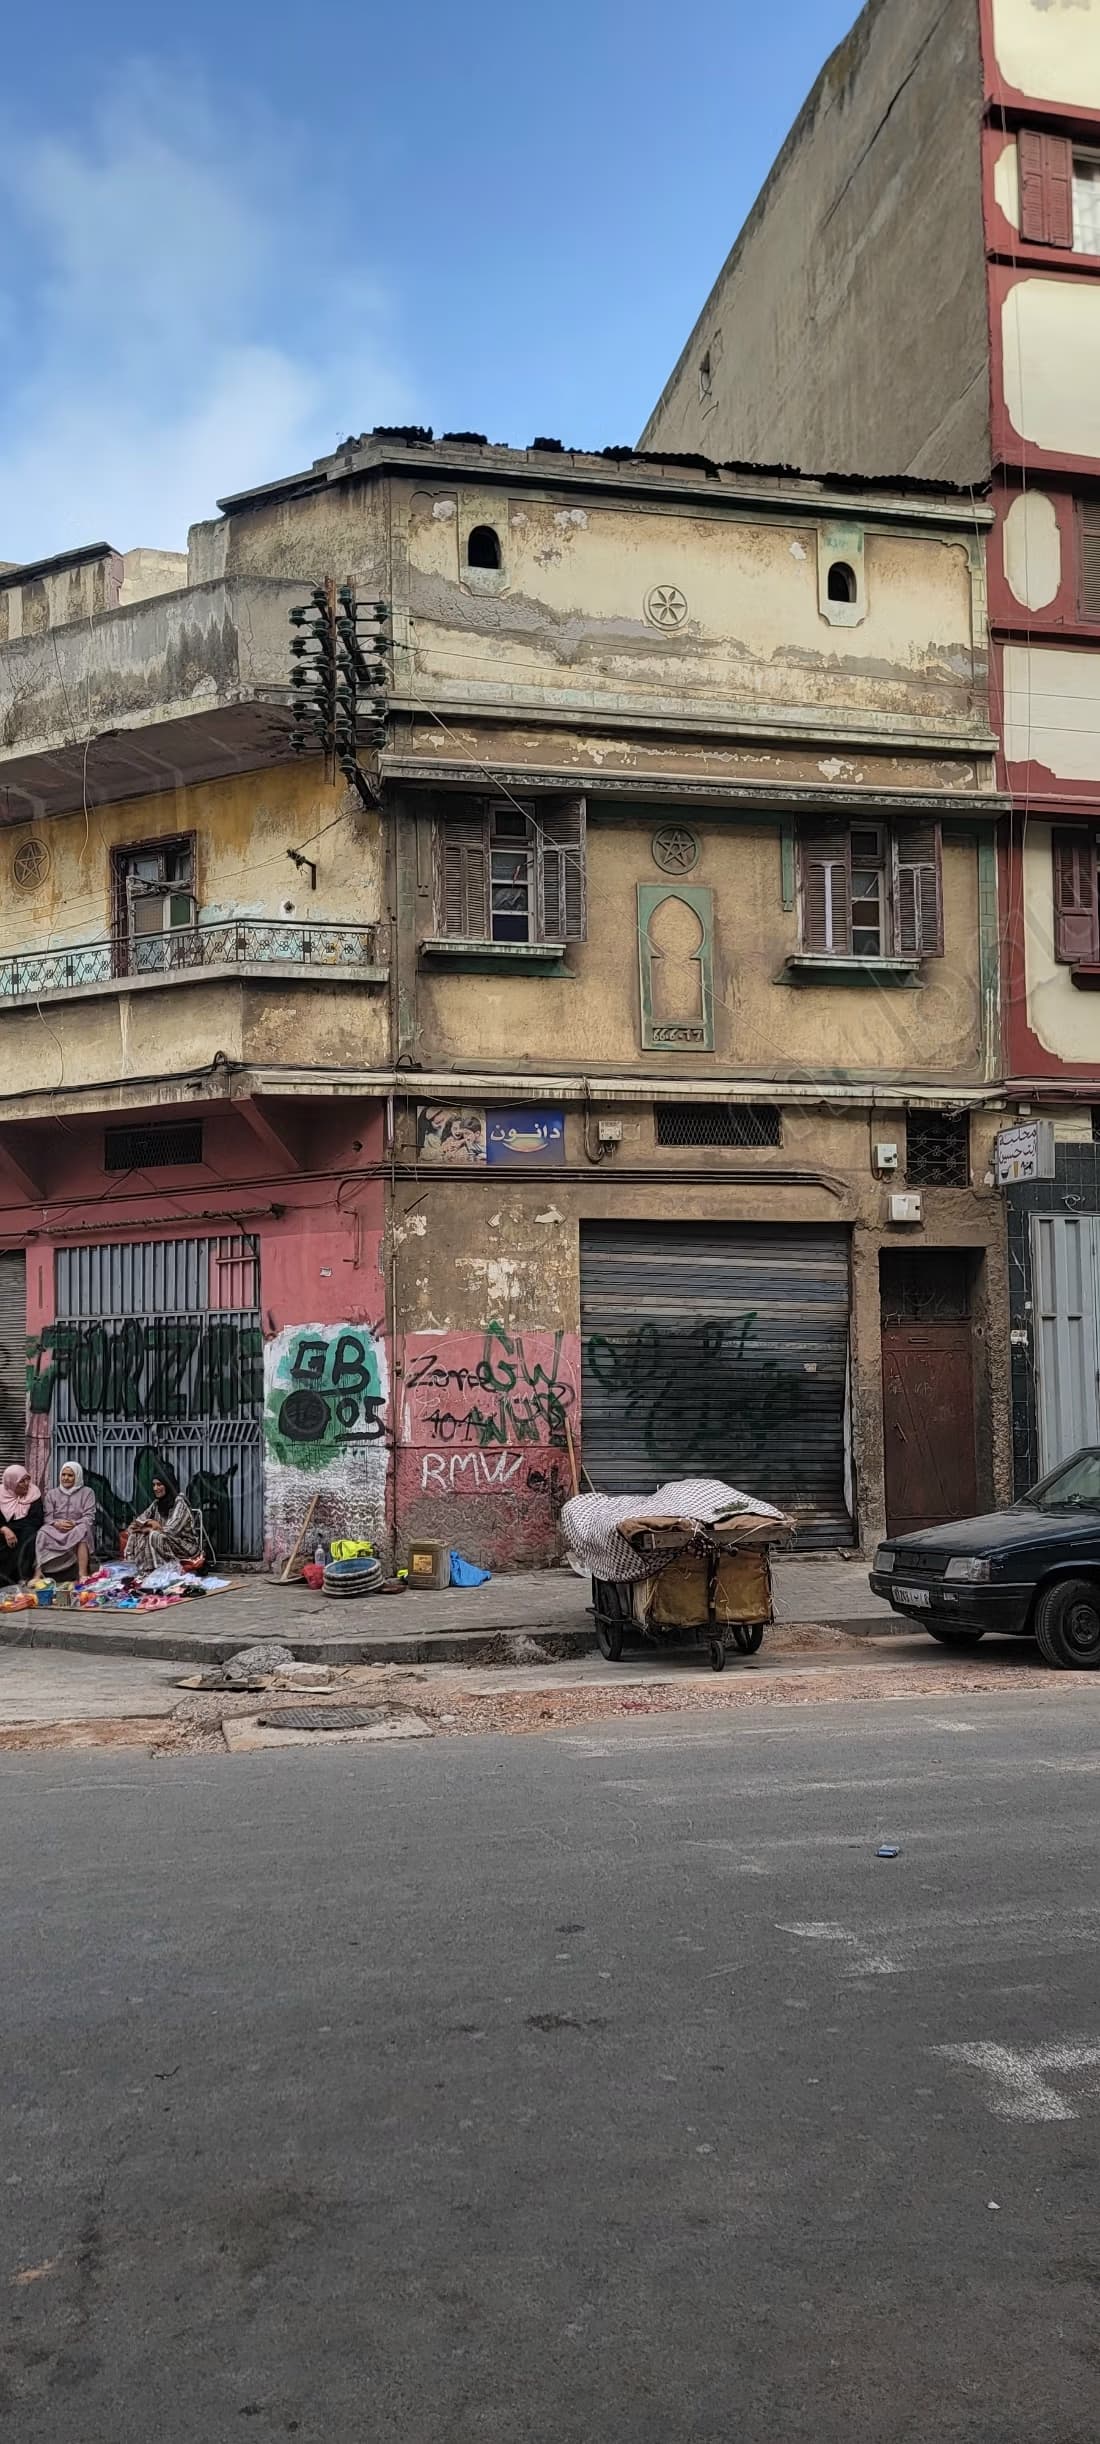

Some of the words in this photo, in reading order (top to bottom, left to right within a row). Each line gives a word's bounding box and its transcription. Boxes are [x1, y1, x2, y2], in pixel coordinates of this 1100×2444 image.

[490, 1123, 561, 1142] دانون
[290, 1335, 371, 1397] GB
[420, 1450, 525, 1493] RMW
